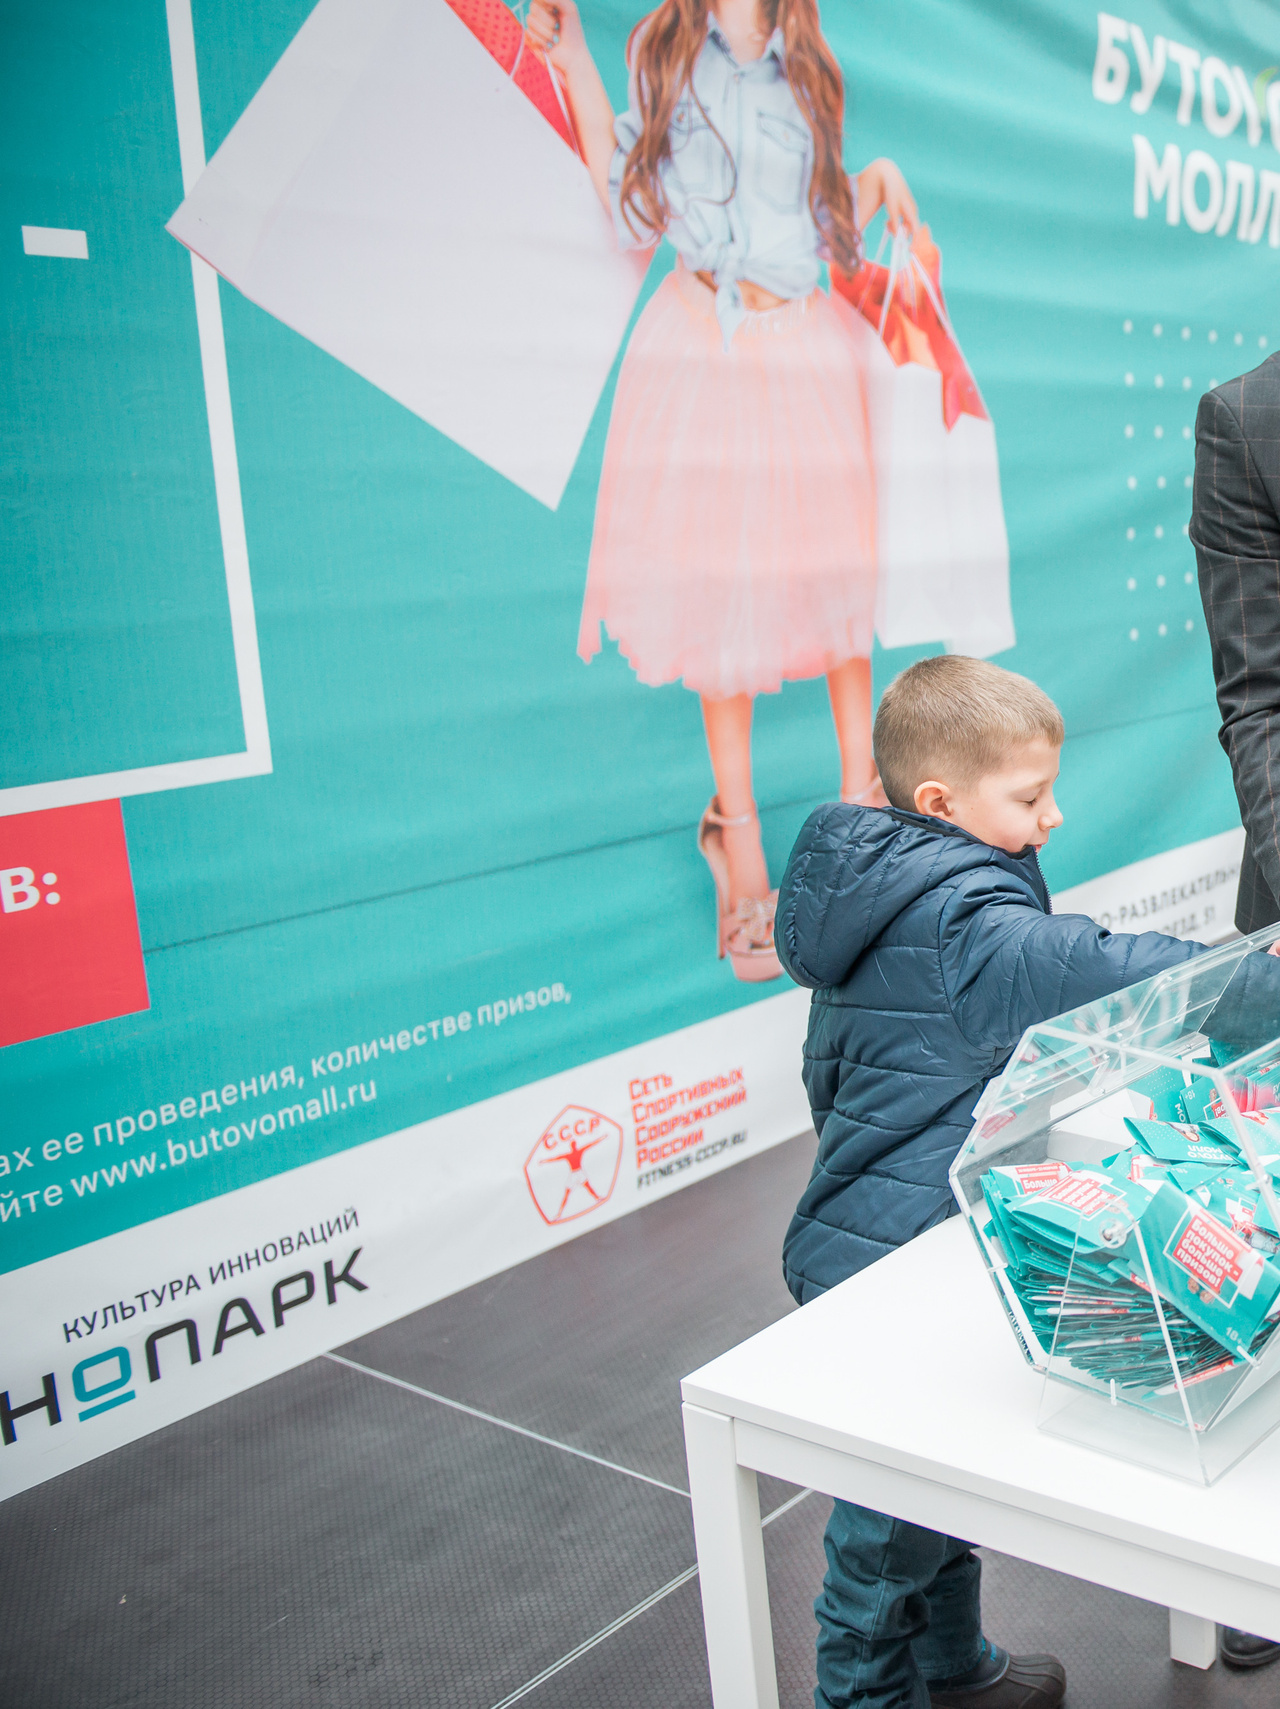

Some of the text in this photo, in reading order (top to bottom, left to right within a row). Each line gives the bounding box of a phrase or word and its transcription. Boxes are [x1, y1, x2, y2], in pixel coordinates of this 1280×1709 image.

[42, 1132, 84, 1162] ее
[93, 1065, 305, 1146] проведения,
[311, 1010, 472, 1078] количестве
[477, 982, 572, 1027] призов,
[70, 1079, 377, 1198] www.butovomall.ru
[542, 1117, 601, 1151] СССР
[1181, 1237, 1223, 1277] больше
[1185, 1229, 1232, 1273] покупок
[1191, 1217, 1234, 1260] Больше
[62, 1206, 360, 1343] КУЛЬТУРА ИННОВАЦИЙ
[1176, 1247, 1221, 1287] призов!
[0, 1246, 370, 1446] НОПАРК
